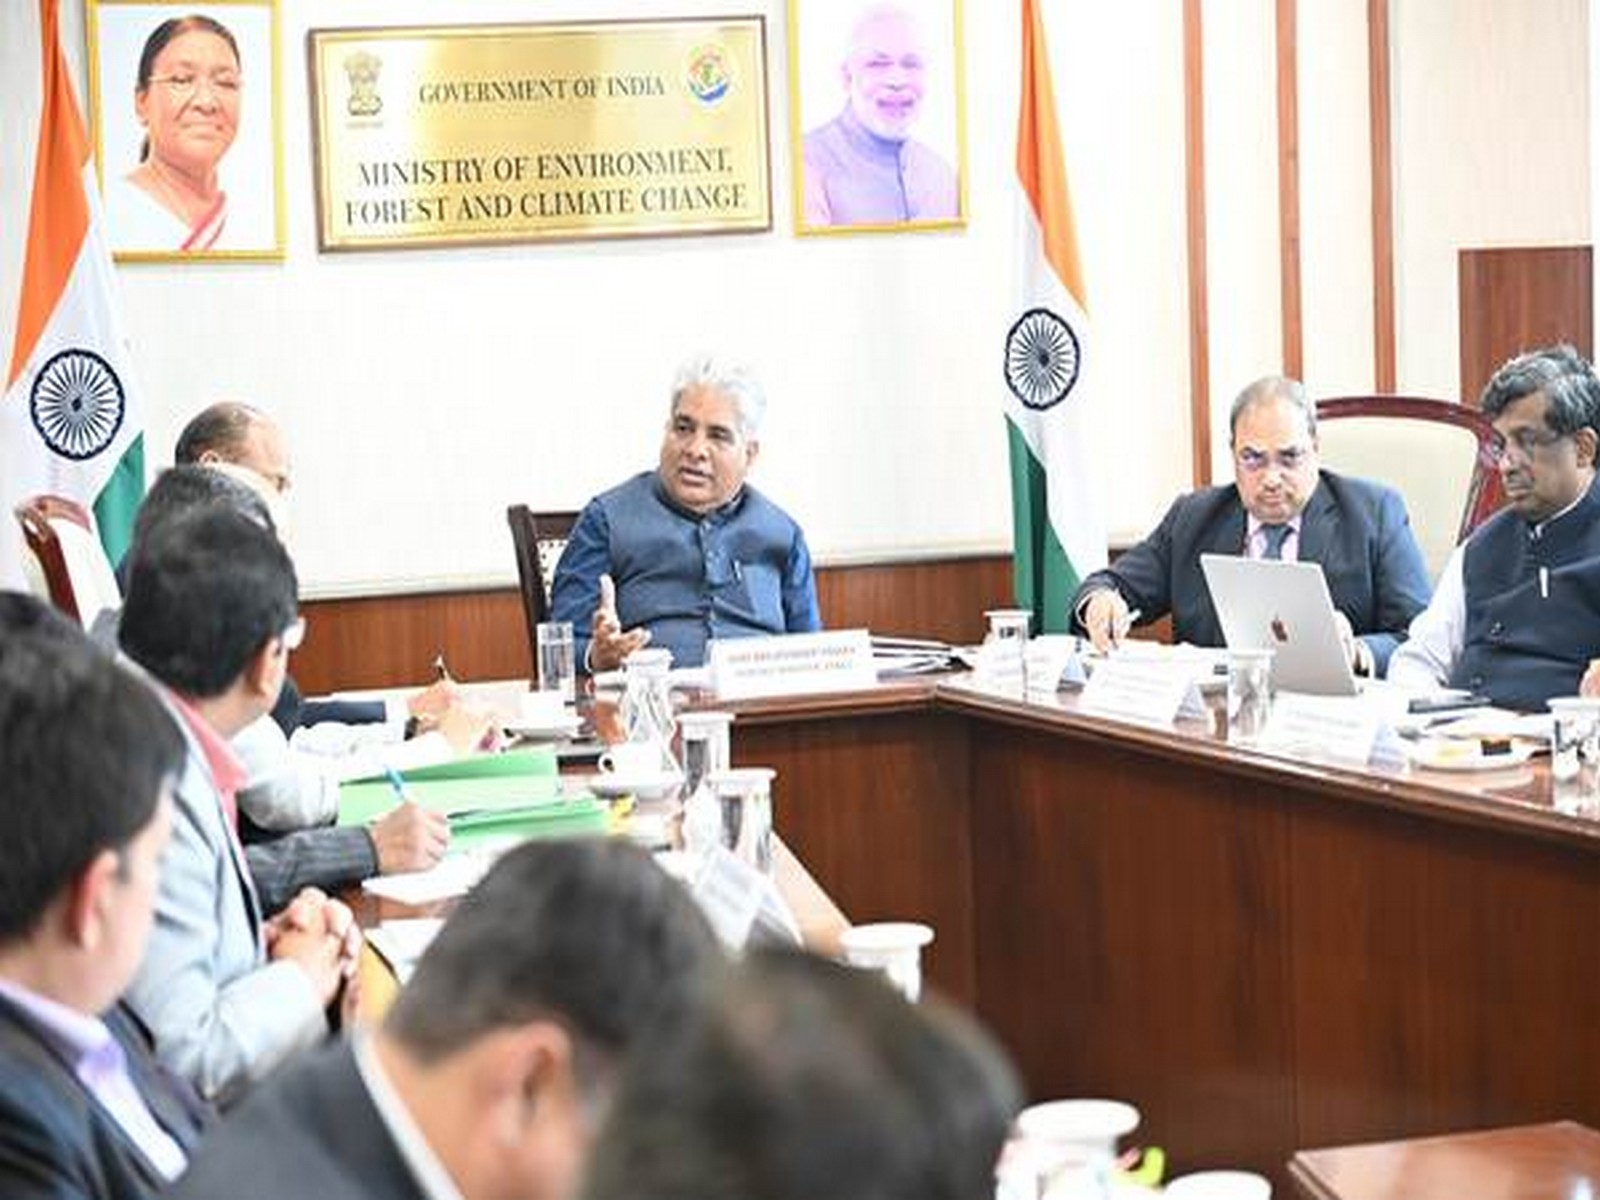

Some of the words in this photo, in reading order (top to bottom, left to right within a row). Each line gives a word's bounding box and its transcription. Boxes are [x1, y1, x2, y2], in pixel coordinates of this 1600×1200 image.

[418, 78, 565, 103] GOVERNMENT
[573, 77, 602, 98] OF
[607, 75, 665, 98] INDIA
[357, 158, 487, 187] MINISTRY
[493, 155, 528, 183] OF
[537, 148, 733, 180] ENVIRONMENT,
[345, 197, 447, 226] FOREST
[456, 193, 514, 220] AND
[520, 188, 633, 217] CLIMATE
[640, 184, 747, 211] CHANGE
